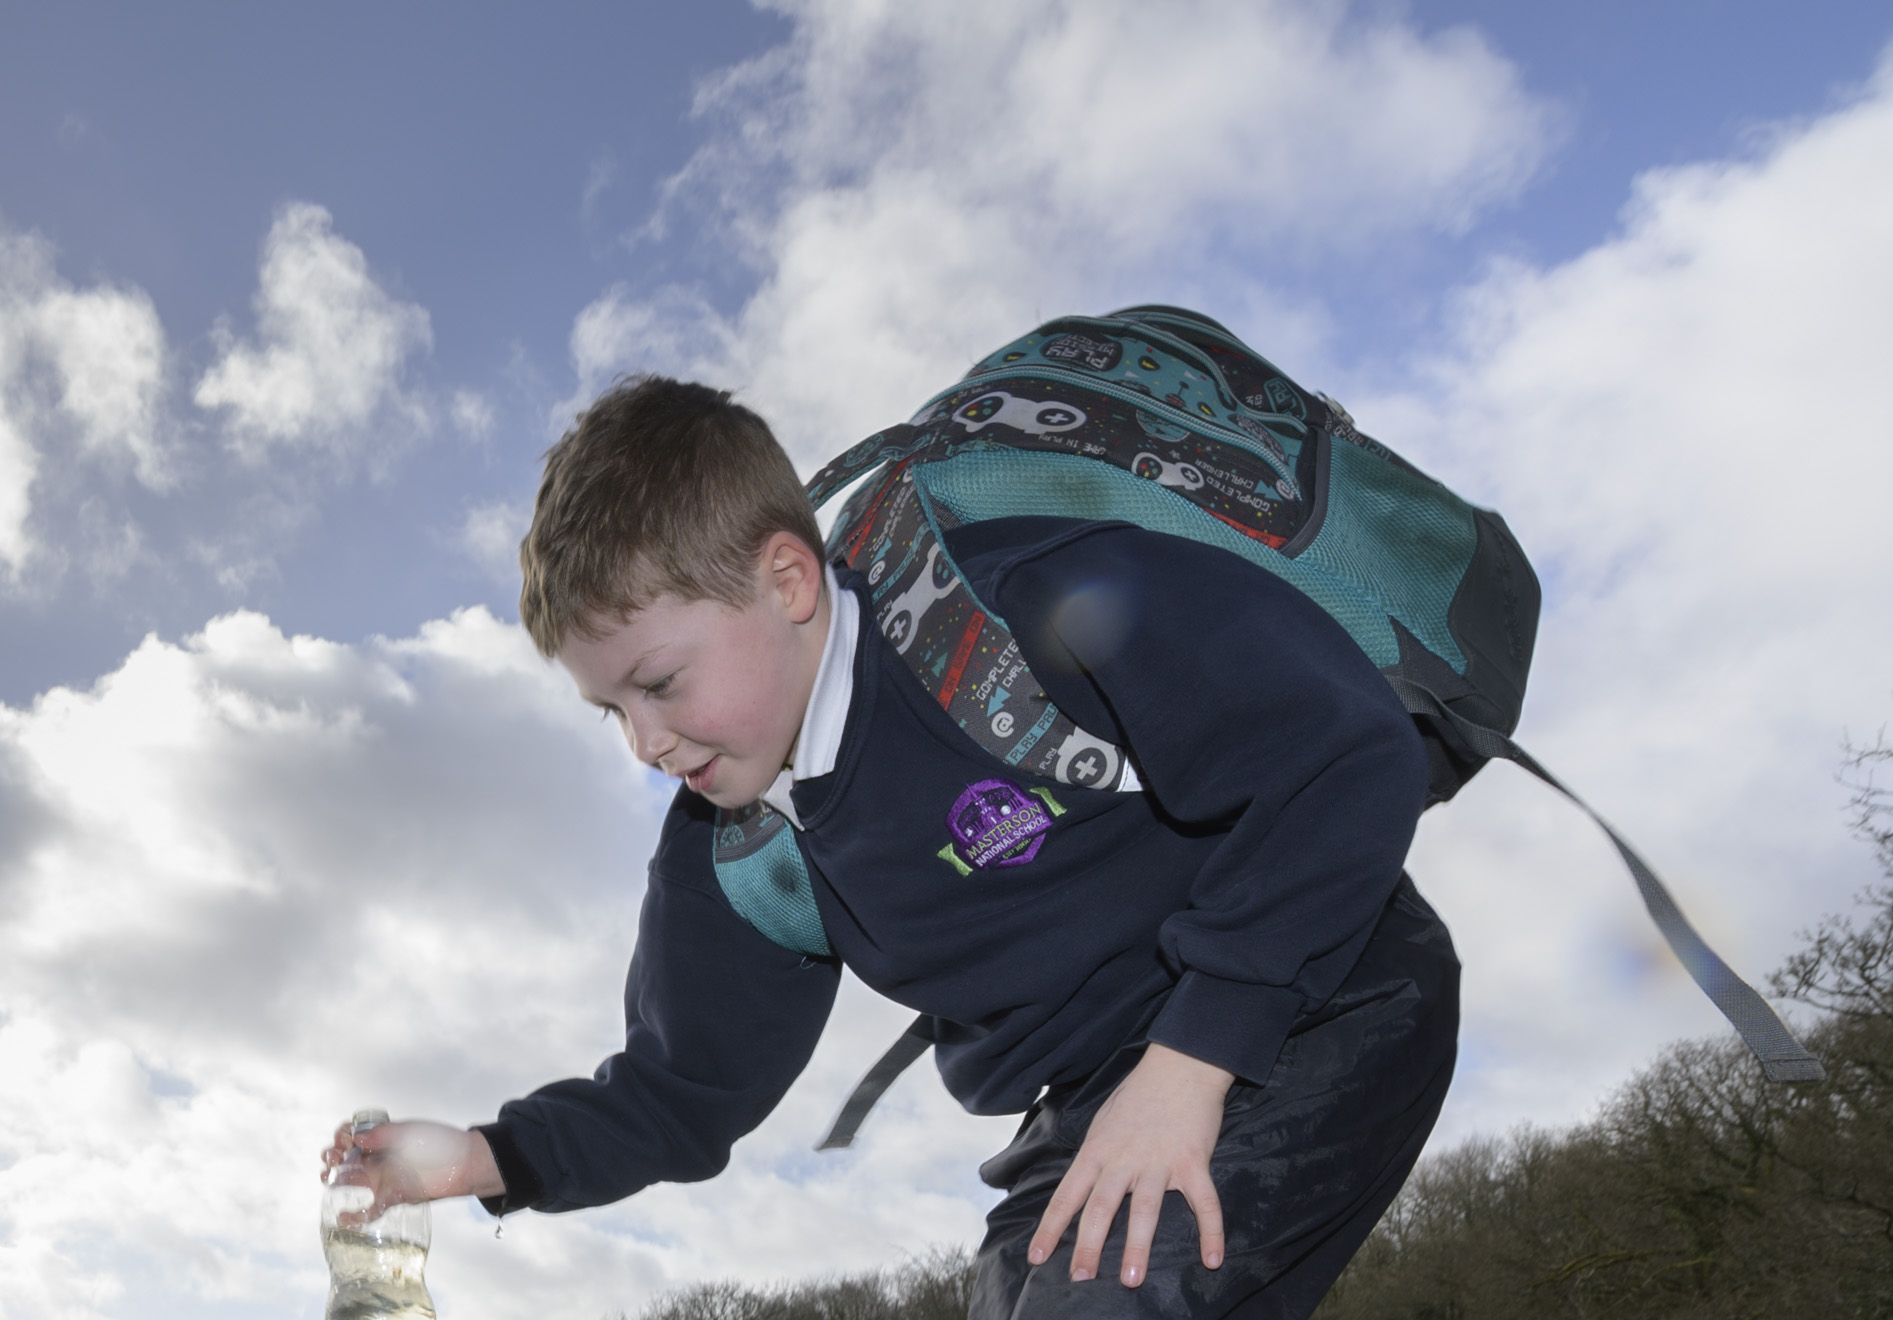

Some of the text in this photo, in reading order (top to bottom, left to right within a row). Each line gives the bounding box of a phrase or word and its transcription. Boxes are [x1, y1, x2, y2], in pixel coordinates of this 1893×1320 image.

[1038, 434, 1107, 455] GAME IN PLAY
[1194, 457, 1255, 490] CHALLENGER
[1011, 704, 1059, 766] PLAY PAU
[1038, 746, 1059, 771] PLAY
[966, 801, 1043, 860] MASTERSON
[975, 835, 1015, 868] NATIONAL
[1012, 814, 1048, 841] SCHOOL
